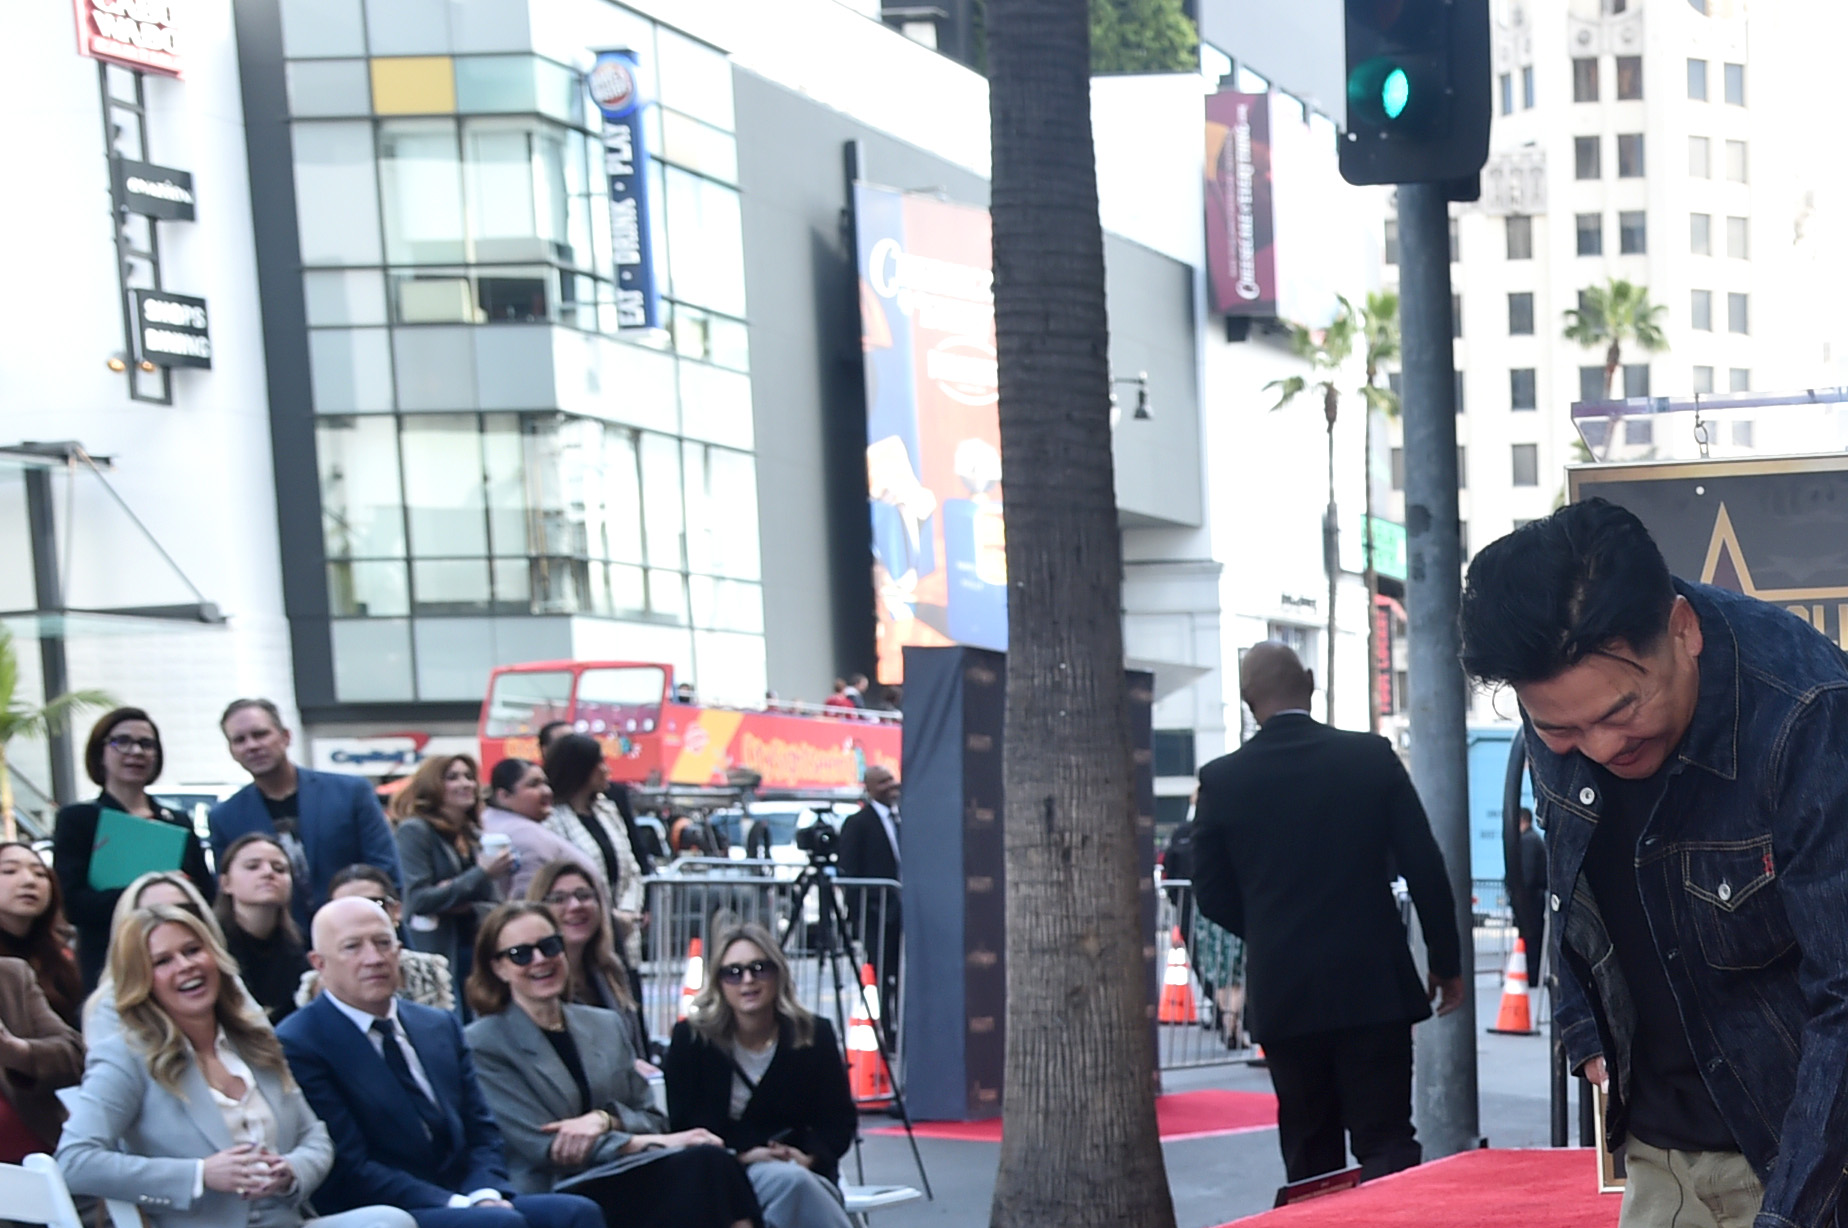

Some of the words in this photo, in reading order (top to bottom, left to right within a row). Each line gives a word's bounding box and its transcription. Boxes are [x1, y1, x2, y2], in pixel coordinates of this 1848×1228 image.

[601, 121, 635, 176] PLAY
[611, 197, 641, 265] DRINK
[144, 298, 207, 329] SHOPS
[616, 289, 646, 327] EAT
